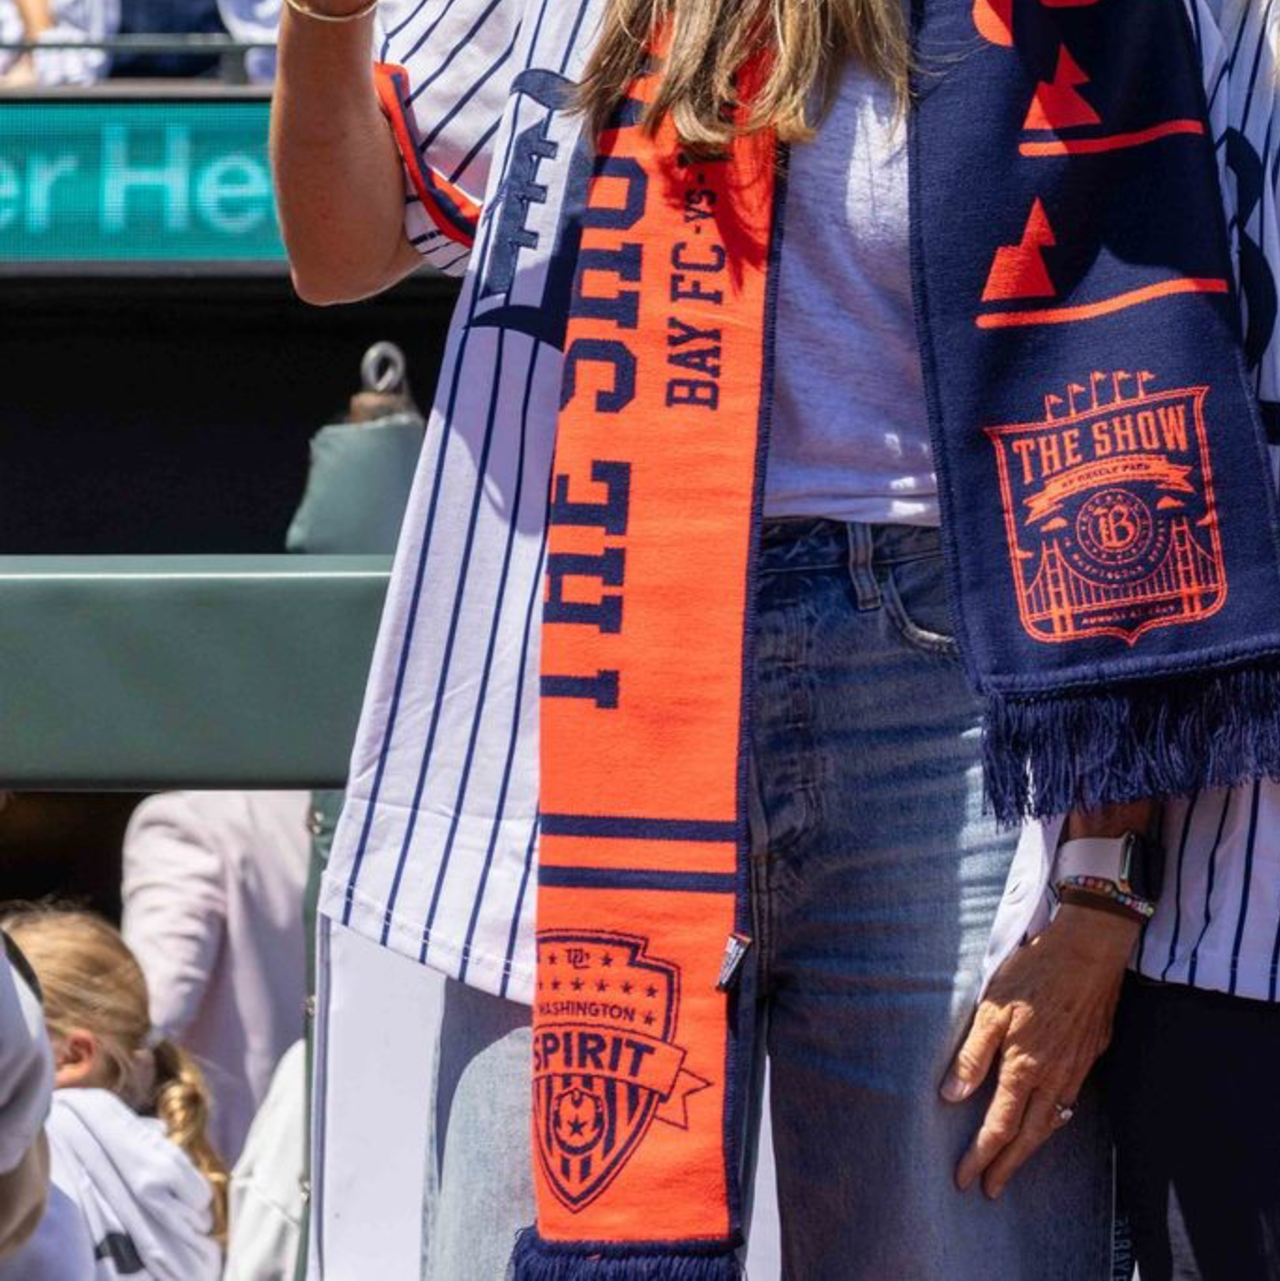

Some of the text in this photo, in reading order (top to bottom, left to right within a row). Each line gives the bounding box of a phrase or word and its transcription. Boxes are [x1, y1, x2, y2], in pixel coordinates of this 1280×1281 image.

[671, 241, 726, 306] FC
[665, 317, 722, 410] BAY
[1012, 404, 1189, 485] THE SHOW
[534, 1031, 656, 1077] SPIRIT
